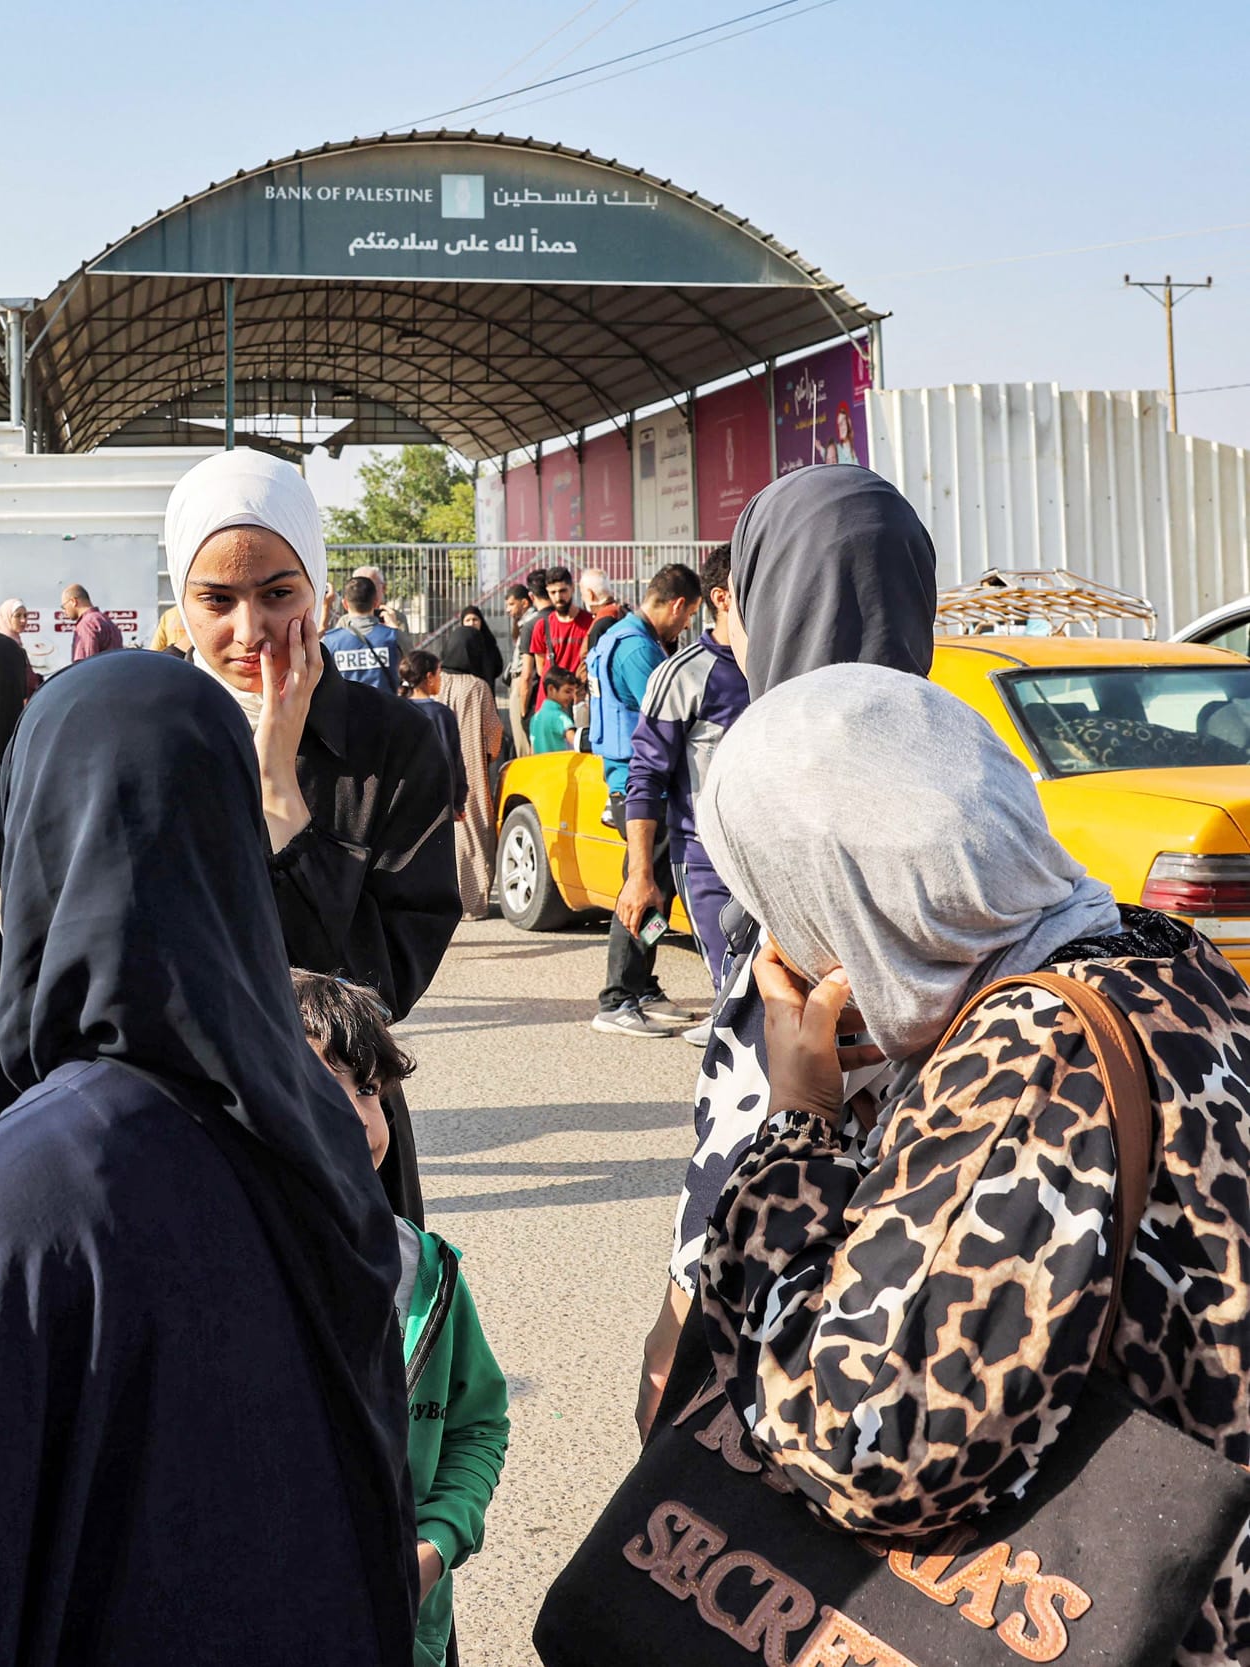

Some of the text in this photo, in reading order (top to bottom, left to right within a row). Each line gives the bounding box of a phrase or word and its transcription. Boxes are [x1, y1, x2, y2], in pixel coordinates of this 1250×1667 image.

[265, 186, 434, 202] BANK OF PALESTINE
[349, 232, 438, 256] سلامتكم
[444, 234, 489, 255] على
[495, 234, 524, 252] لله
[336, 650, 387, 667] PRESS
